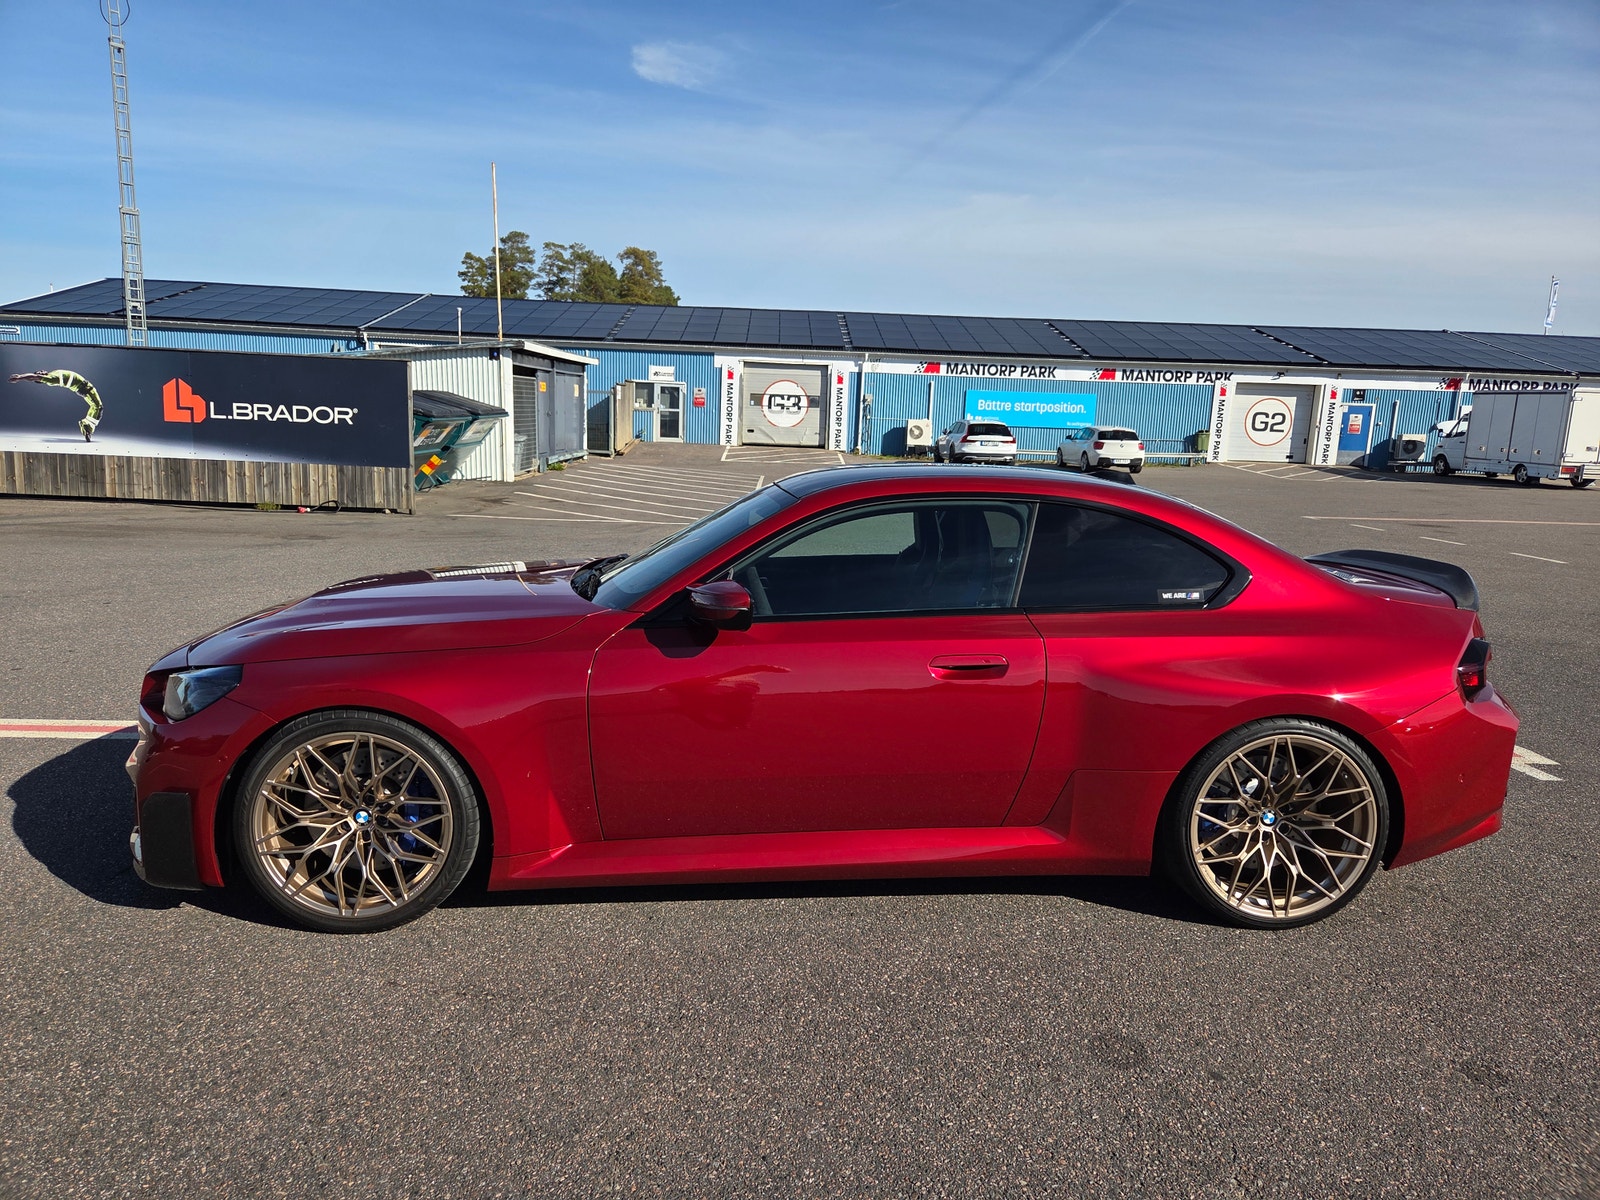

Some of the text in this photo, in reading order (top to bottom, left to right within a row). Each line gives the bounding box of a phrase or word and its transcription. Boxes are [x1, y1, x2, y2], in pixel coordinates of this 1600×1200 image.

[946, 362, 1058, 379] MANTORP PARK
[1121, 368, 1234, 383] MANTORP PARK
[725, 382, 734, 445] MANTORP PARK
[767, 393, 802, 415] G3
[977, 399, 1087, 415] Bättre startposition.
[834, 387, 844, 449] MANTORP PARK
[1251, 411, 1286, 433] G2
[1212, 399, 1226, 461] MANTORP PARK
[1321, 402, 1336, 464] MANTORP PARK
